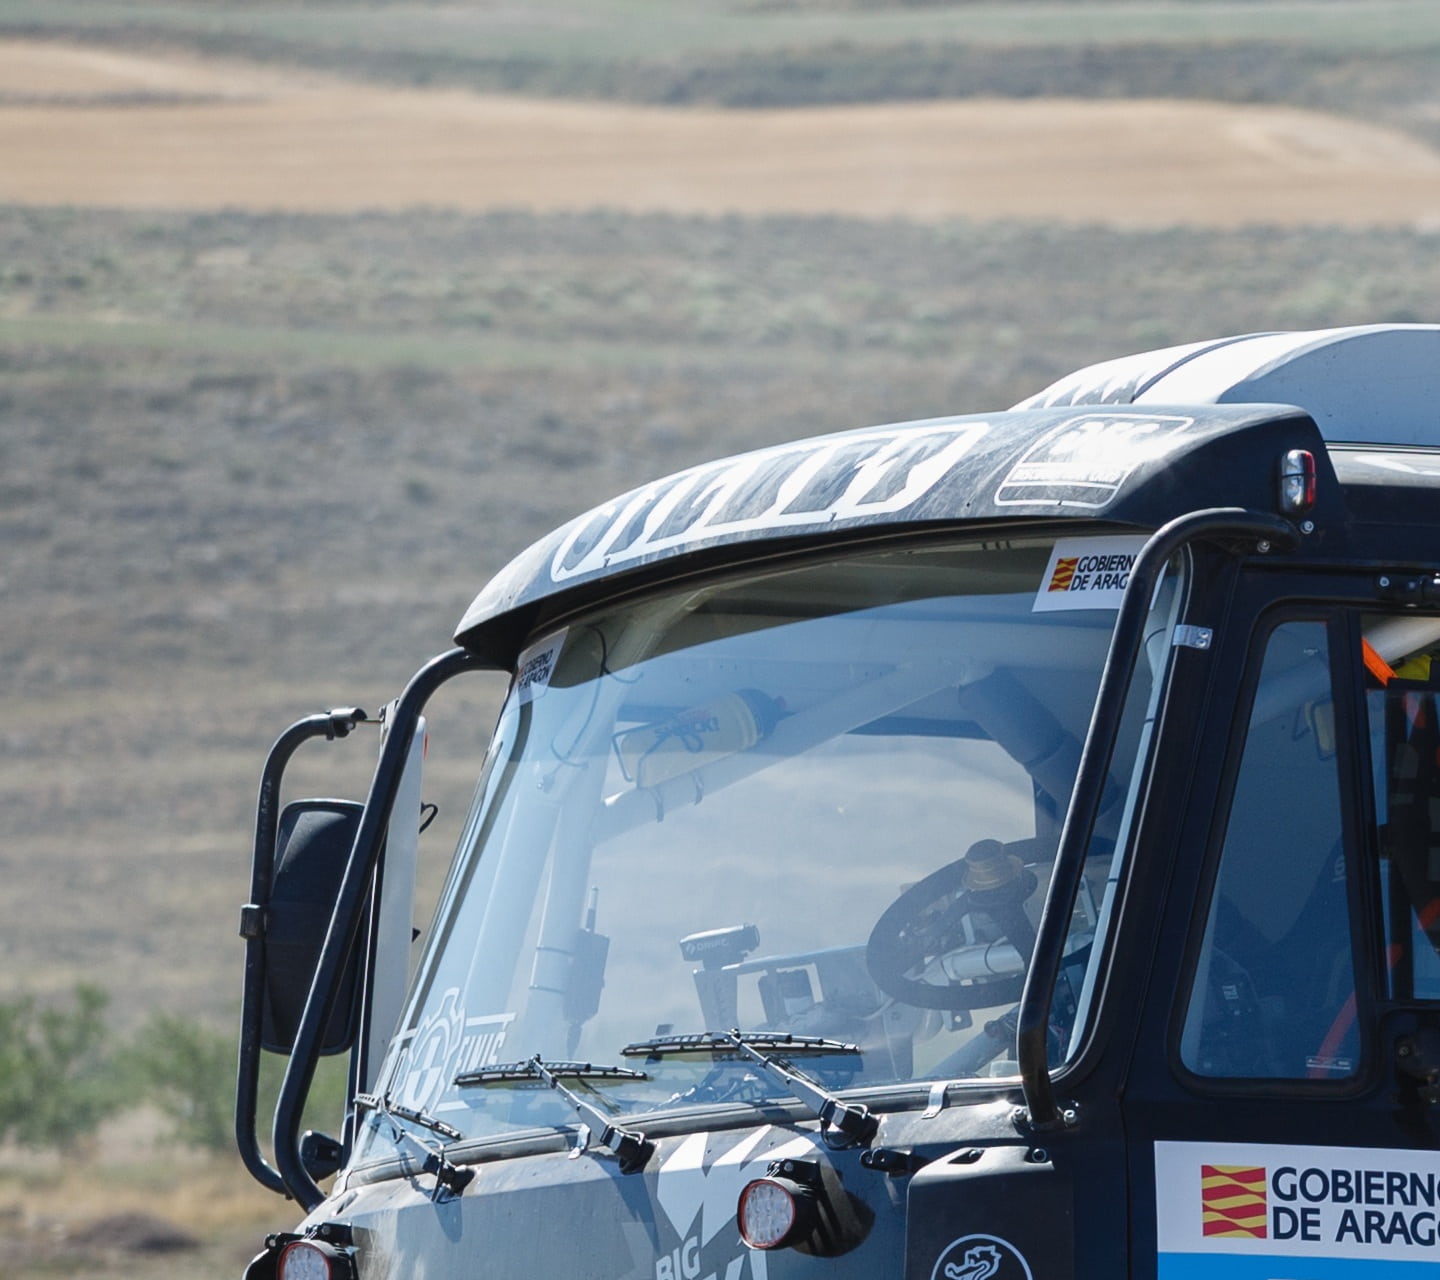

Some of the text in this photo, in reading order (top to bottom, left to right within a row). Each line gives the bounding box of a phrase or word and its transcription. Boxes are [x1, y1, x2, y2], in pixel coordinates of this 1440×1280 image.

[1077, 554, 1138, 573] GOBIERN
[1070, 573, 1130, 591] DE ARAG
[1271, 1207, 1322, 1241] DE
